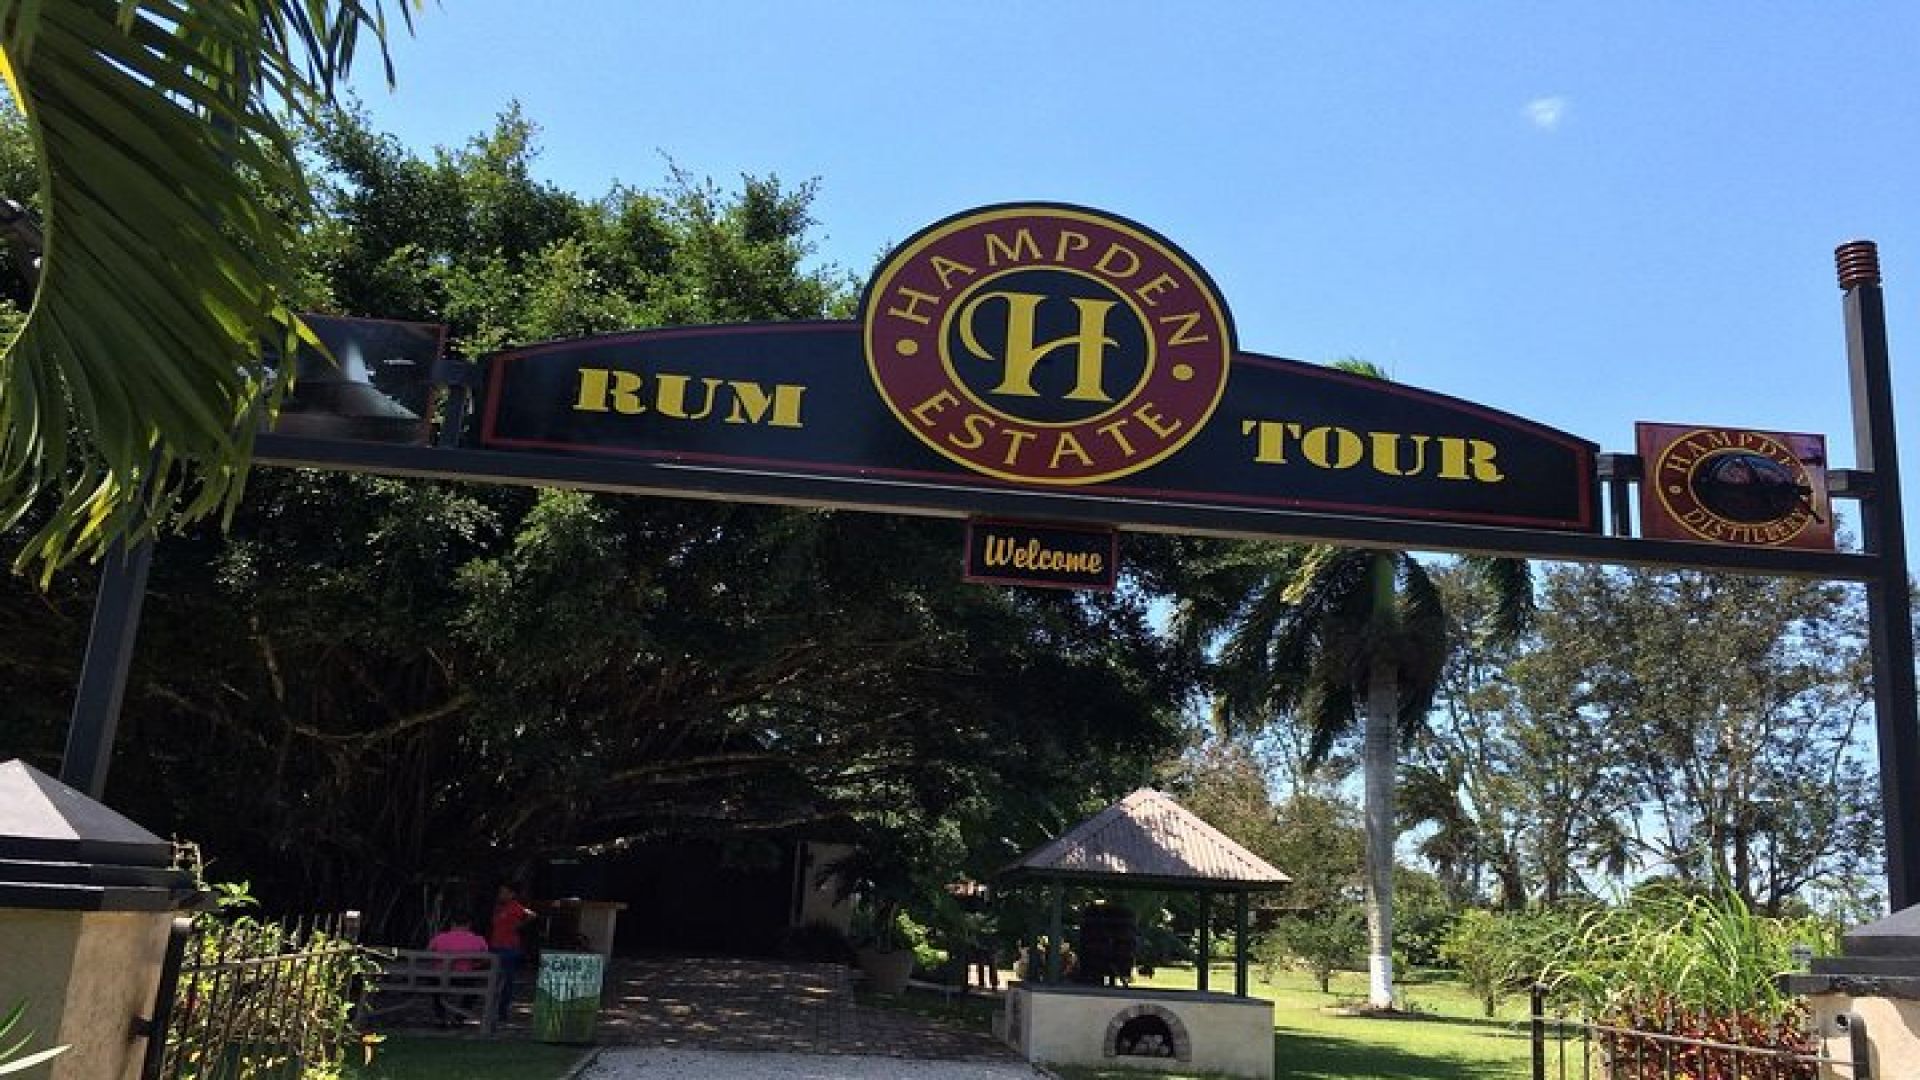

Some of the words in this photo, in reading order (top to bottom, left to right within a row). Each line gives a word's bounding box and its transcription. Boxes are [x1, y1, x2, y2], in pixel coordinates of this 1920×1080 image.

[887, 228, 1209, 346] HAMPDEN
[959, 291, 1120, 401] H
[573, 368, 808, 428] RUM
[1241, 420, 1505, 483] TOUR
[911, 389, 1182, 469] ESTATE
[1666, 431, 1809, 485] HAMPD
[985, 534, 1105, 574] Welcome
